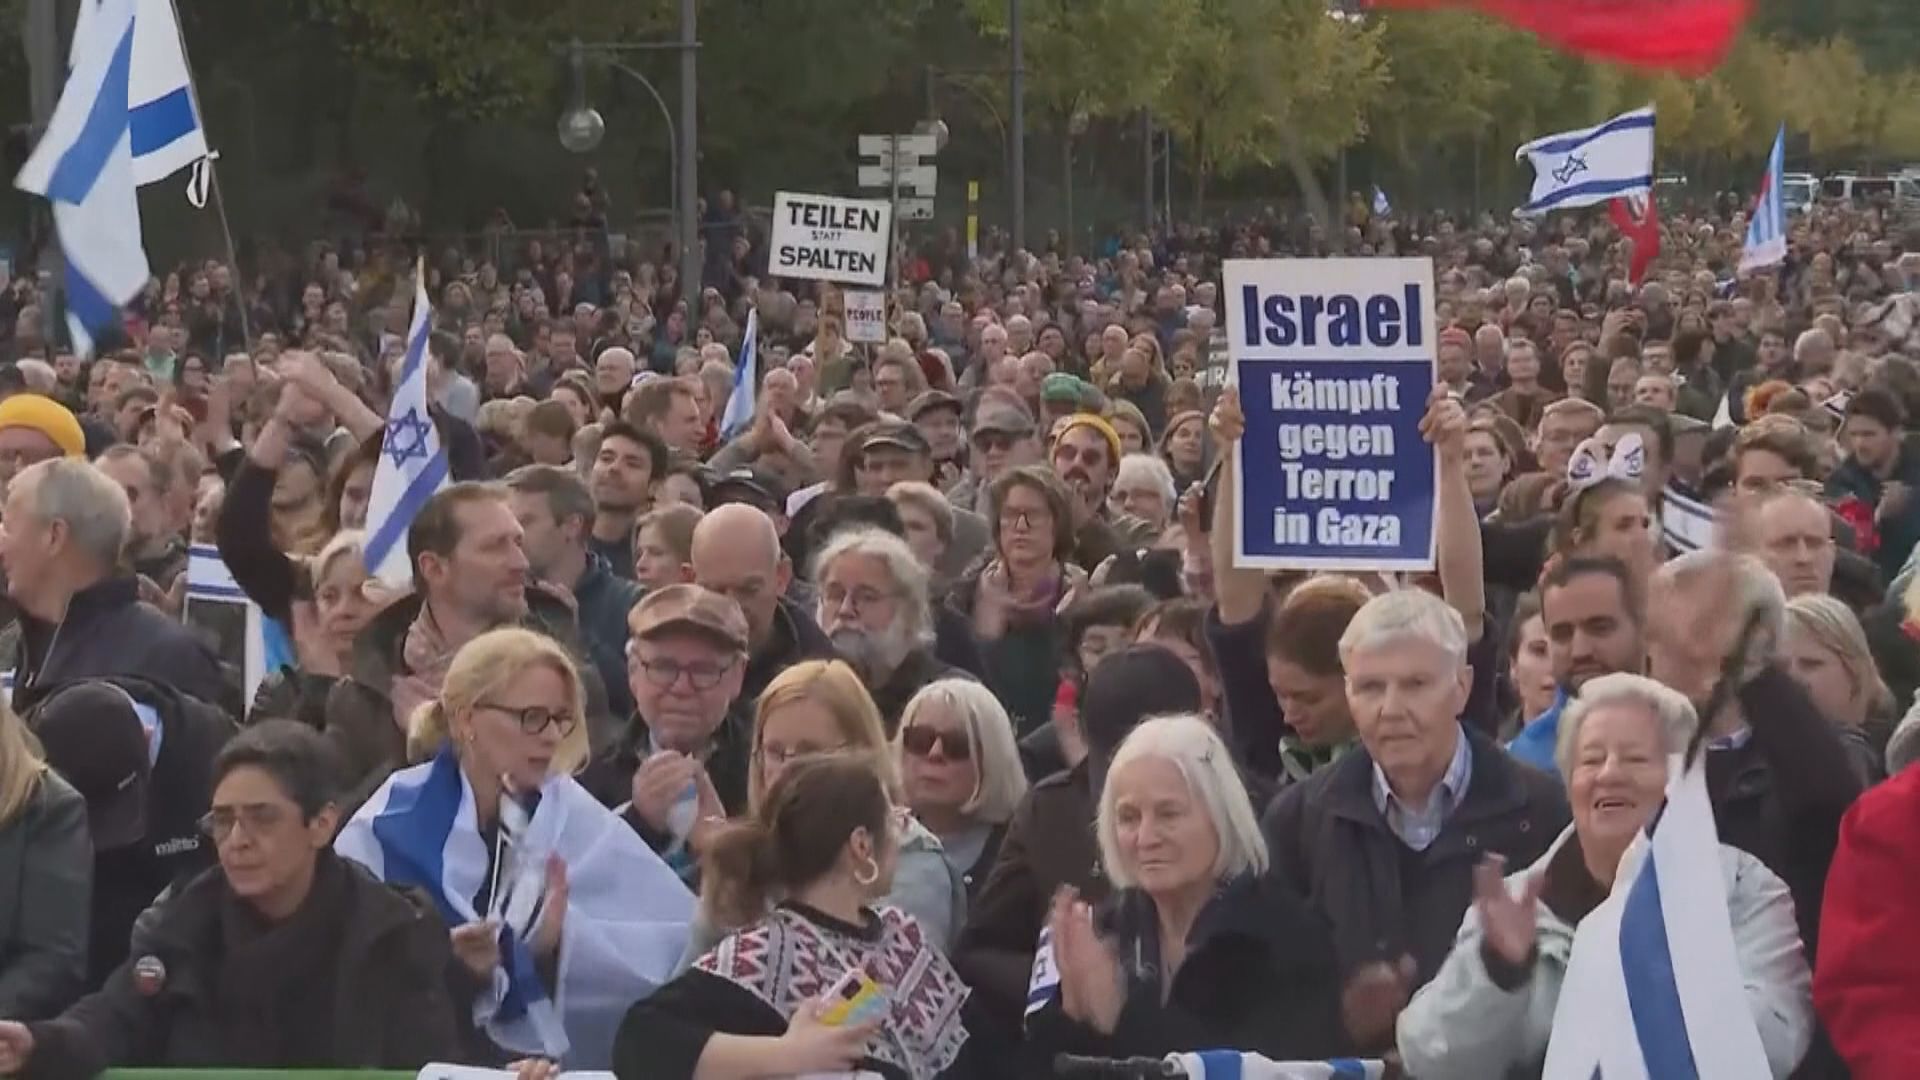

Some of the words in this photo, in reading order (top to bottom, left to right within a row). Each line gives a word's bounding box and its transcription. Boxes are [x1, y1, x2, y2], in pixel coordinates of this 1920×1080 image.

[787, 201, 880, 233] TEILEN
[812, 231, 842, 241] STATT
[779, 246, 875, 274] SPALTEN
[847, 309, 882, 321] PEOPLE
[1243, 284, 1423, 347] Israel
[1271, 372, 1400, 414] kämpft
[1278, 423, 1394, 459] gegen
[1281, 462, 1394, 501] Terror
[1274, 507, 1309, 545] in
[1317, 508, 1400, 547] Gaza
